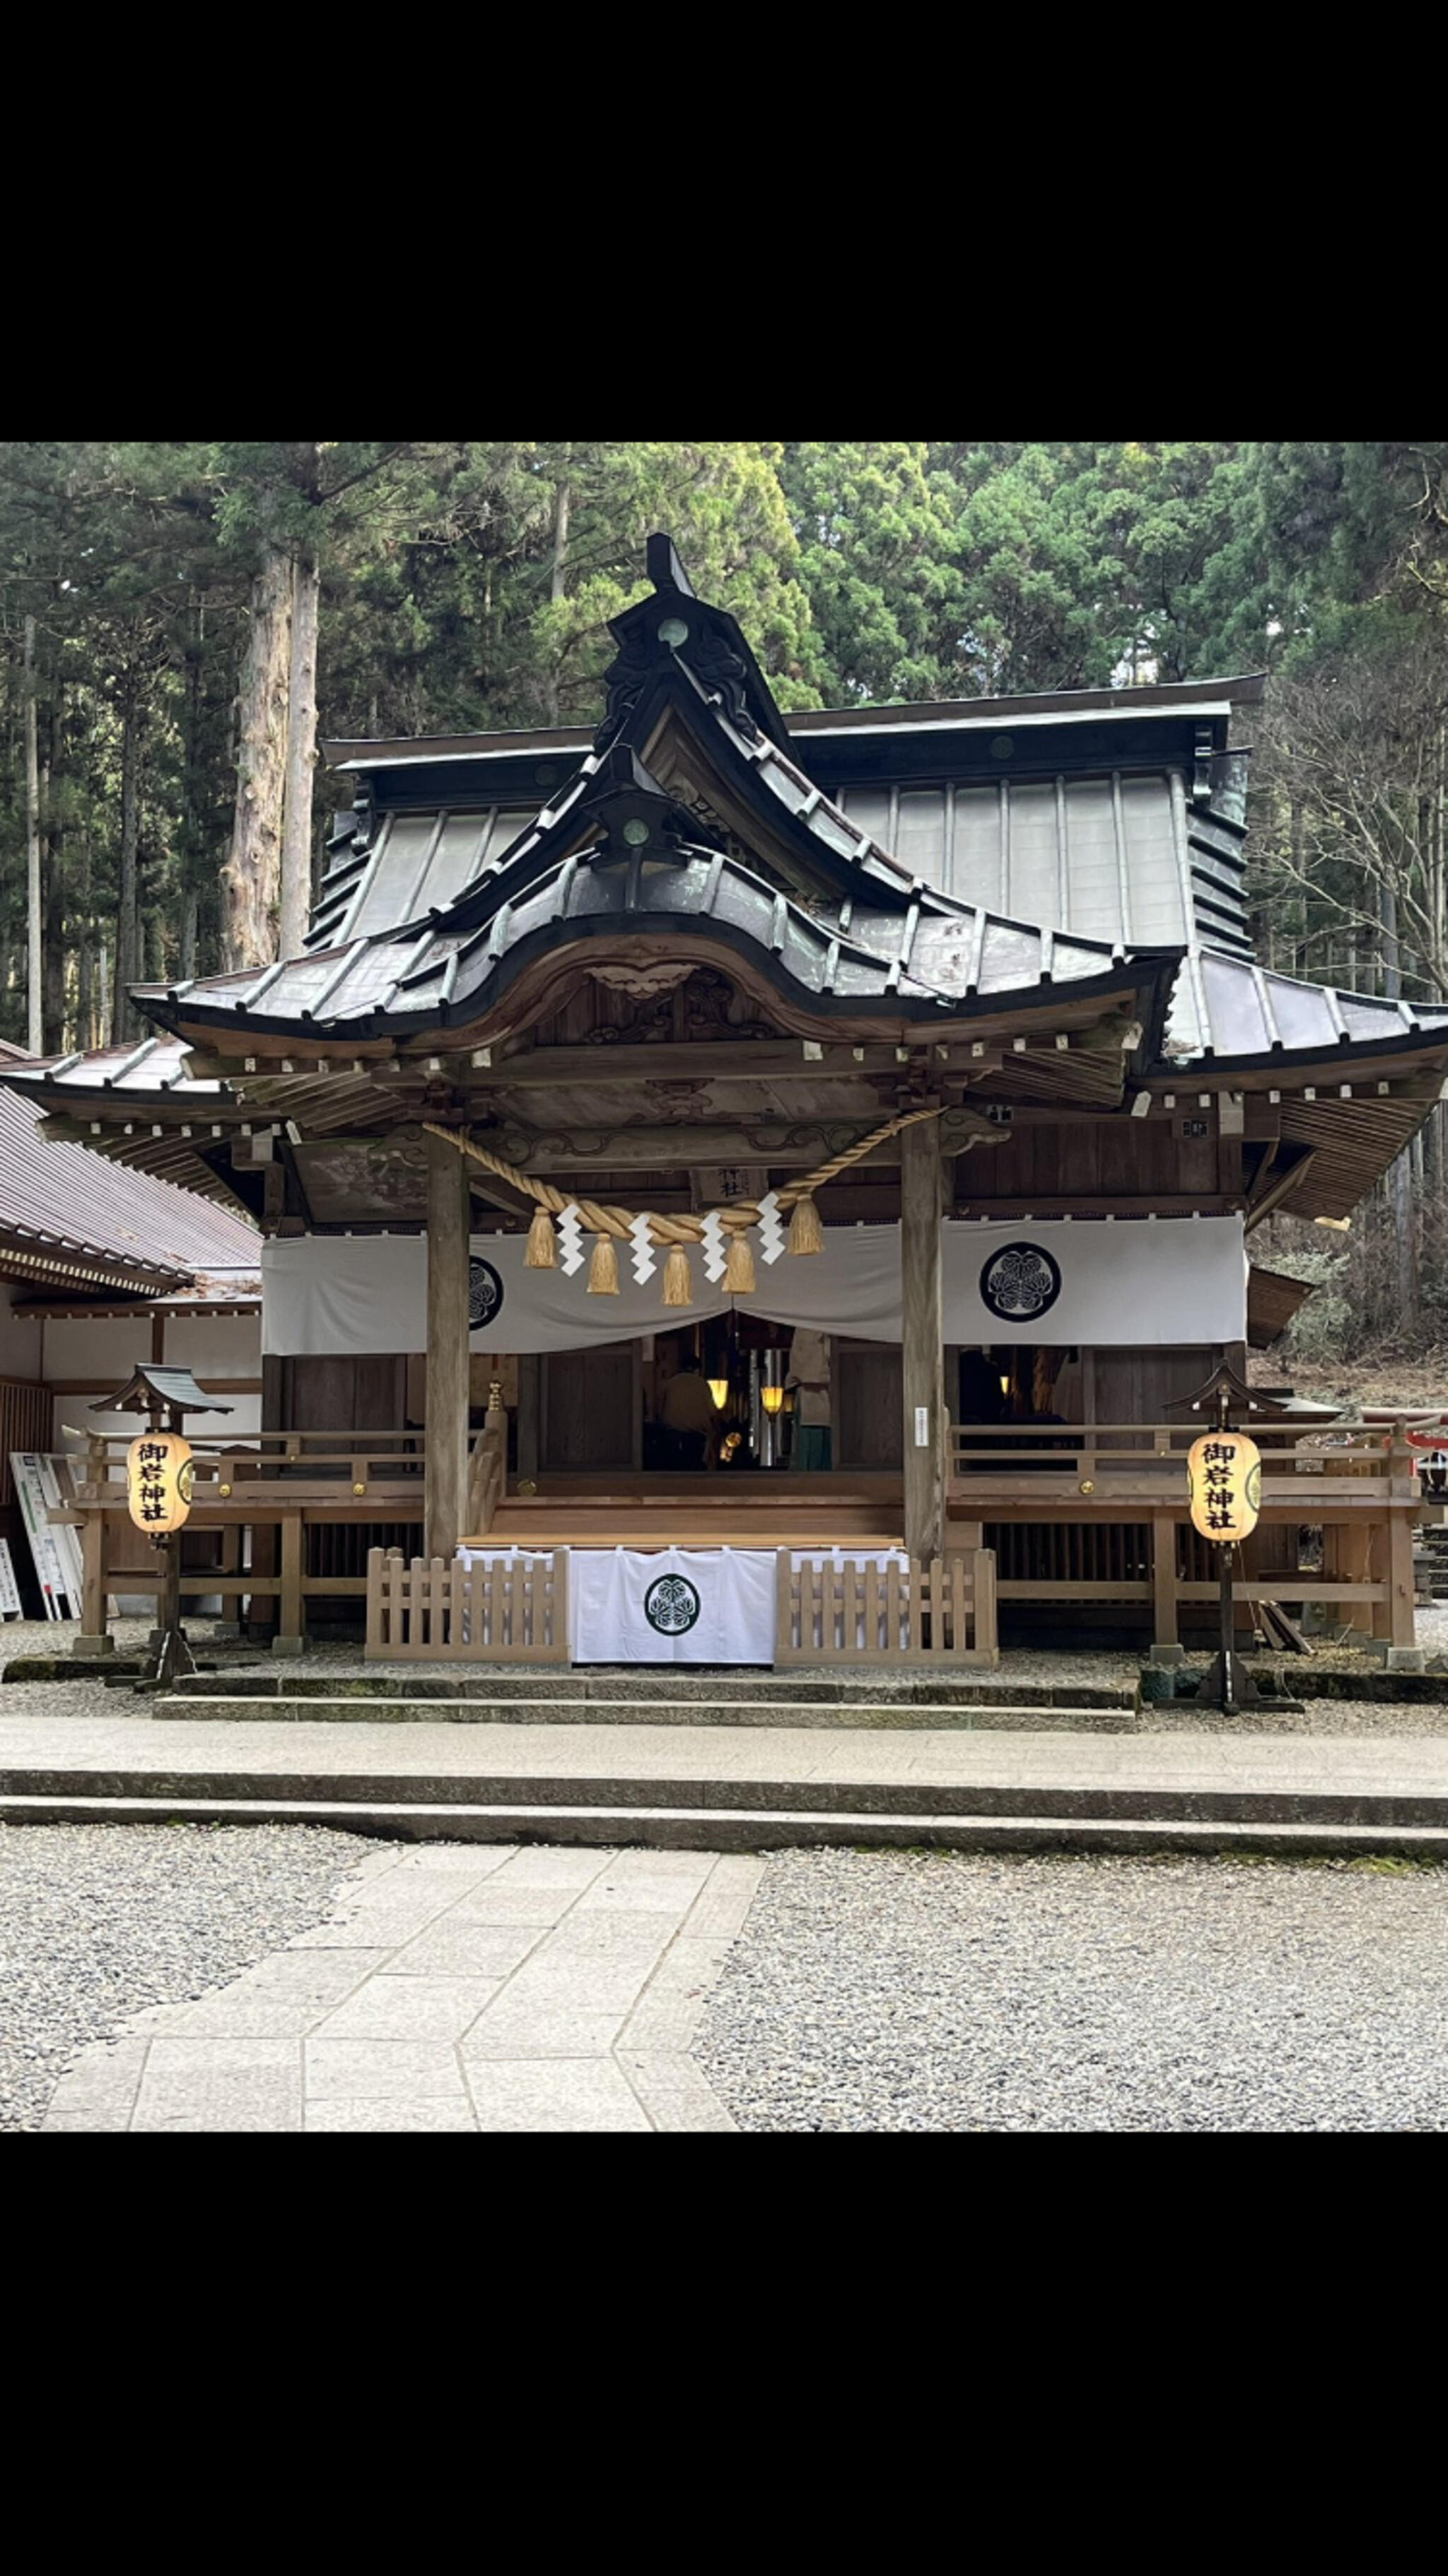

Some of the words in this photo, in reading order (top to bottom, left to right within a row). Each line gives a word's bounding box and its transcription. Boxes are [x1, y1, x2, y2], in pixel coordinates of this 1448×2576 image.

[137, 1442, 168, 1522] 御岩神社
[1201, 1442, 1237, 1529] 御岩神社
